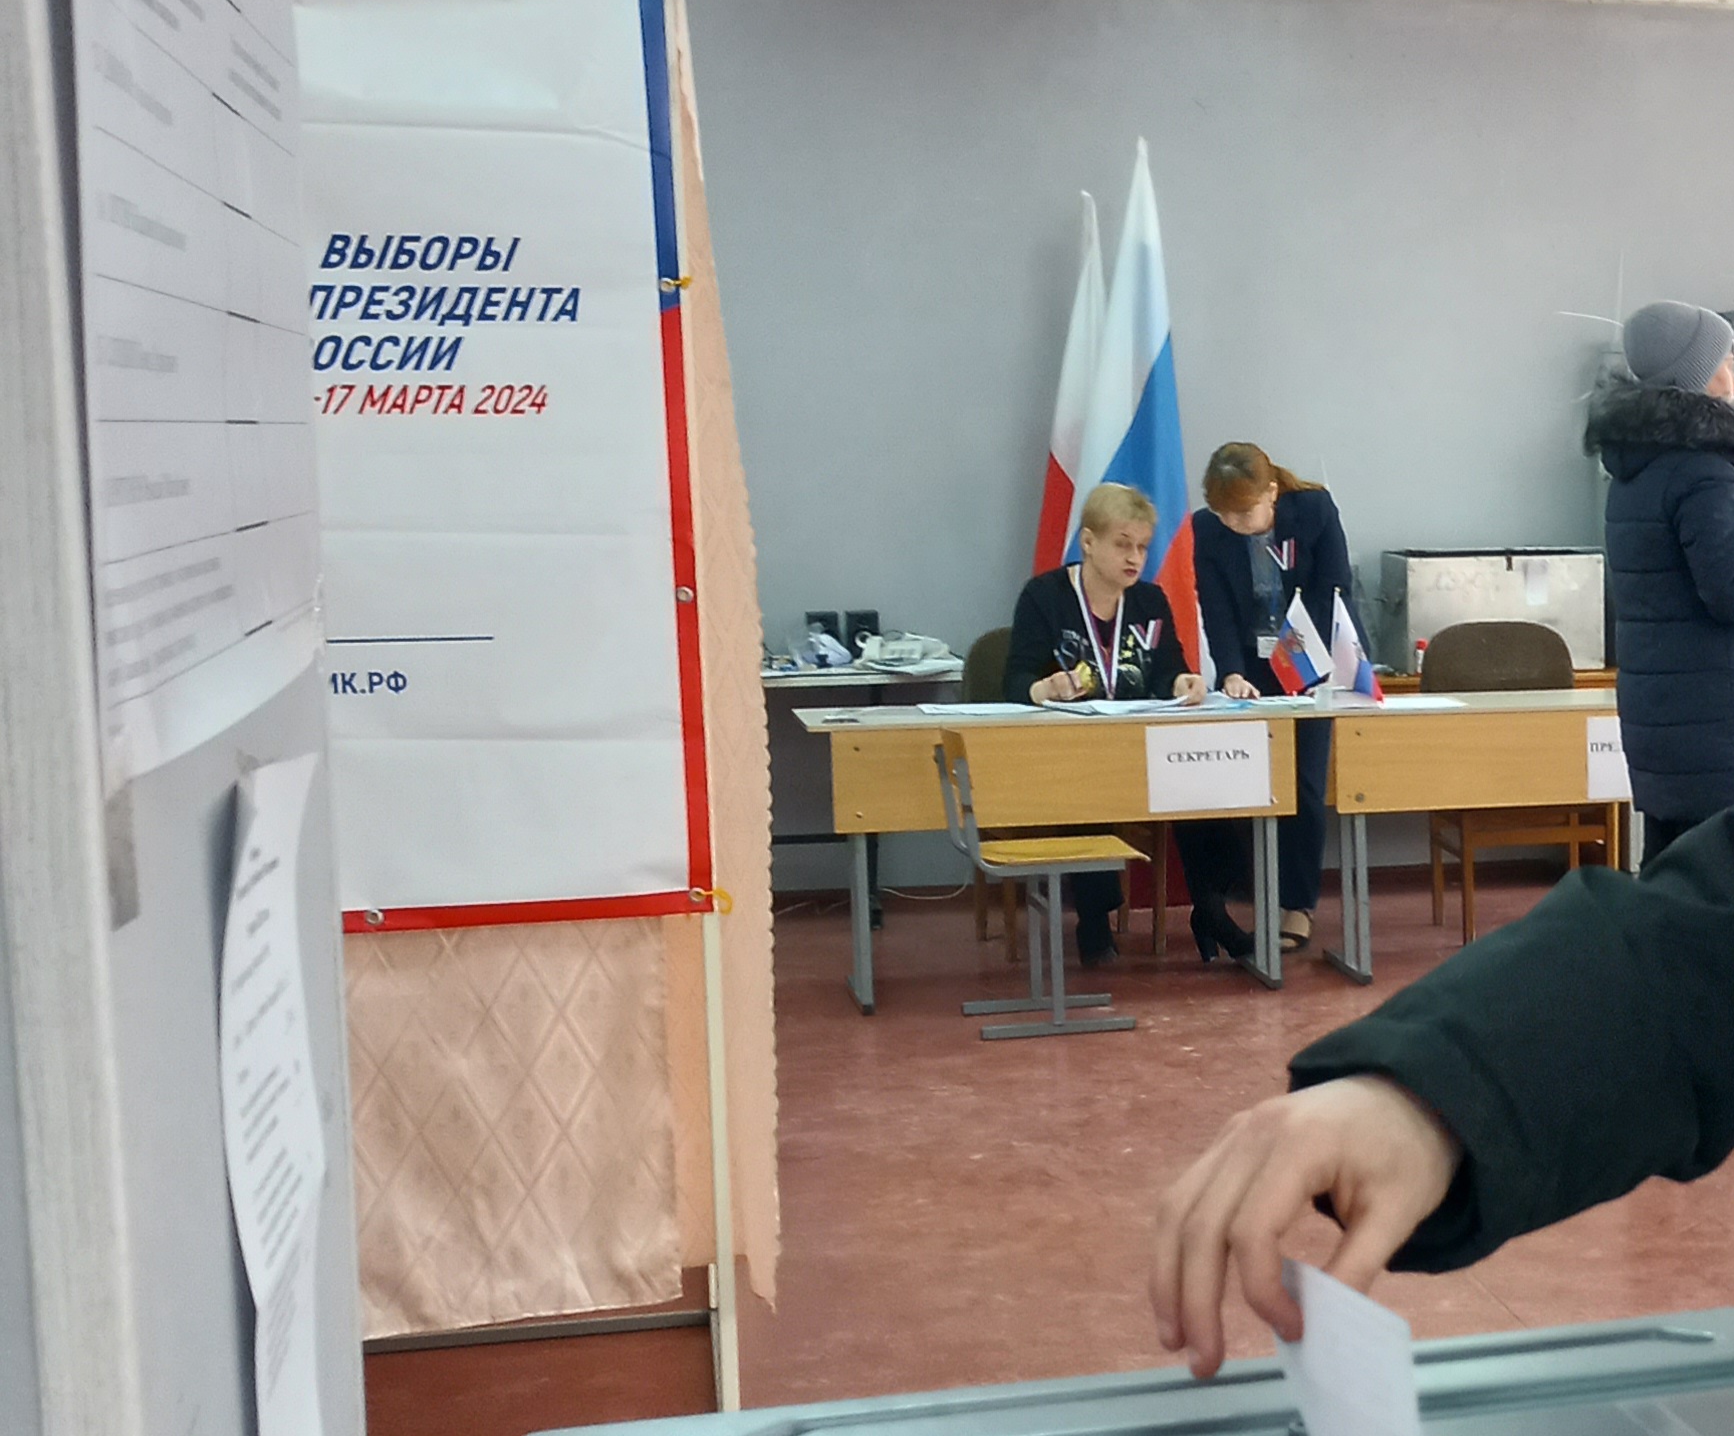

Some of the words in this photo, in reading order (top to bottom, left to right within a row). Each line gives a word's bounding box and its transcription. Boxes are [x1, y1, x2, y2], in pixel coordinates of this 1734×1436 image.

[319, 233, 521, 272] ВЫБОРЫ
[309, 284, 581, 327] ПРЕЗИДЕНТА
[312, 334, 464, 372] ОССИИ
[358, 384, 466, 415] МАРТА
[472, 384, 549, 415] 2024
[1166, 749, 1250, 763] СЕКРЕТАРЬ
